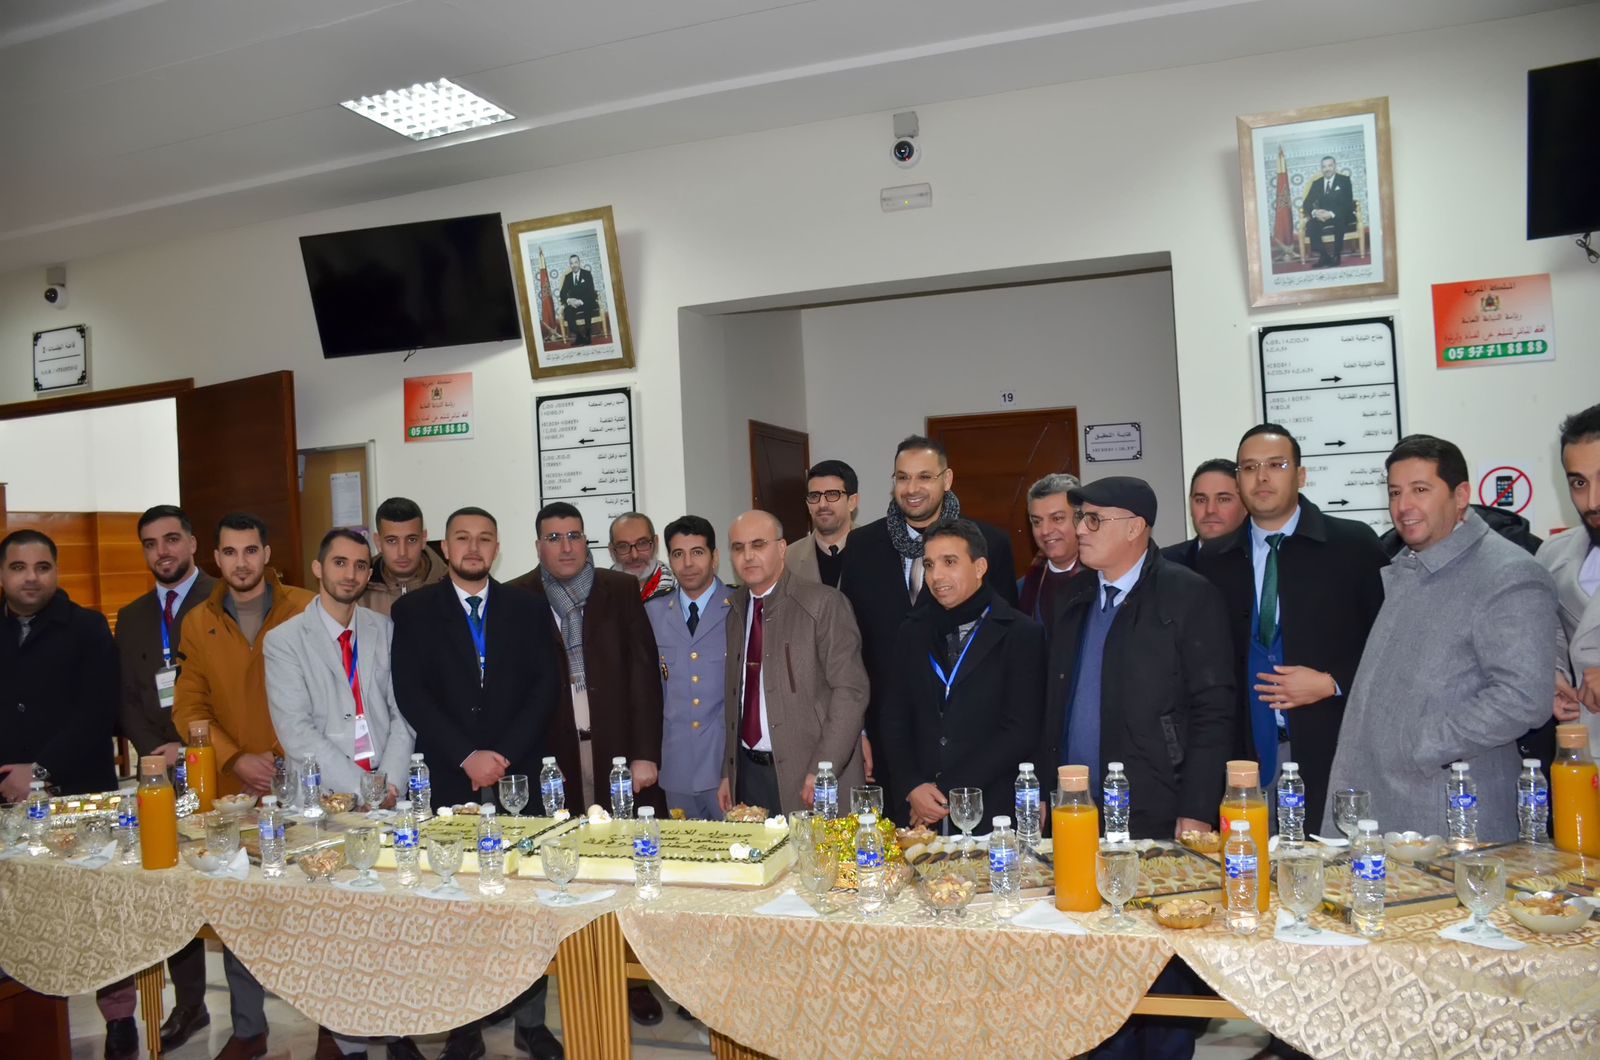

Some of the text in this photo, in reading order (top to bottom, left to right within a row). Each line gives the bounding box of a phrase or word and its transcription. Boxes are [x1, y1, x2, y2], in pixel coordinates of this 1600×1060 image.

[1448, 347, 1464, 360] 05
[1486, 344, 1502, 357] 71
[1507, 342, 1523, 354] 88
[1527, 340, 1543, 353] 88
[1001, 392, 1014, 403] 19
